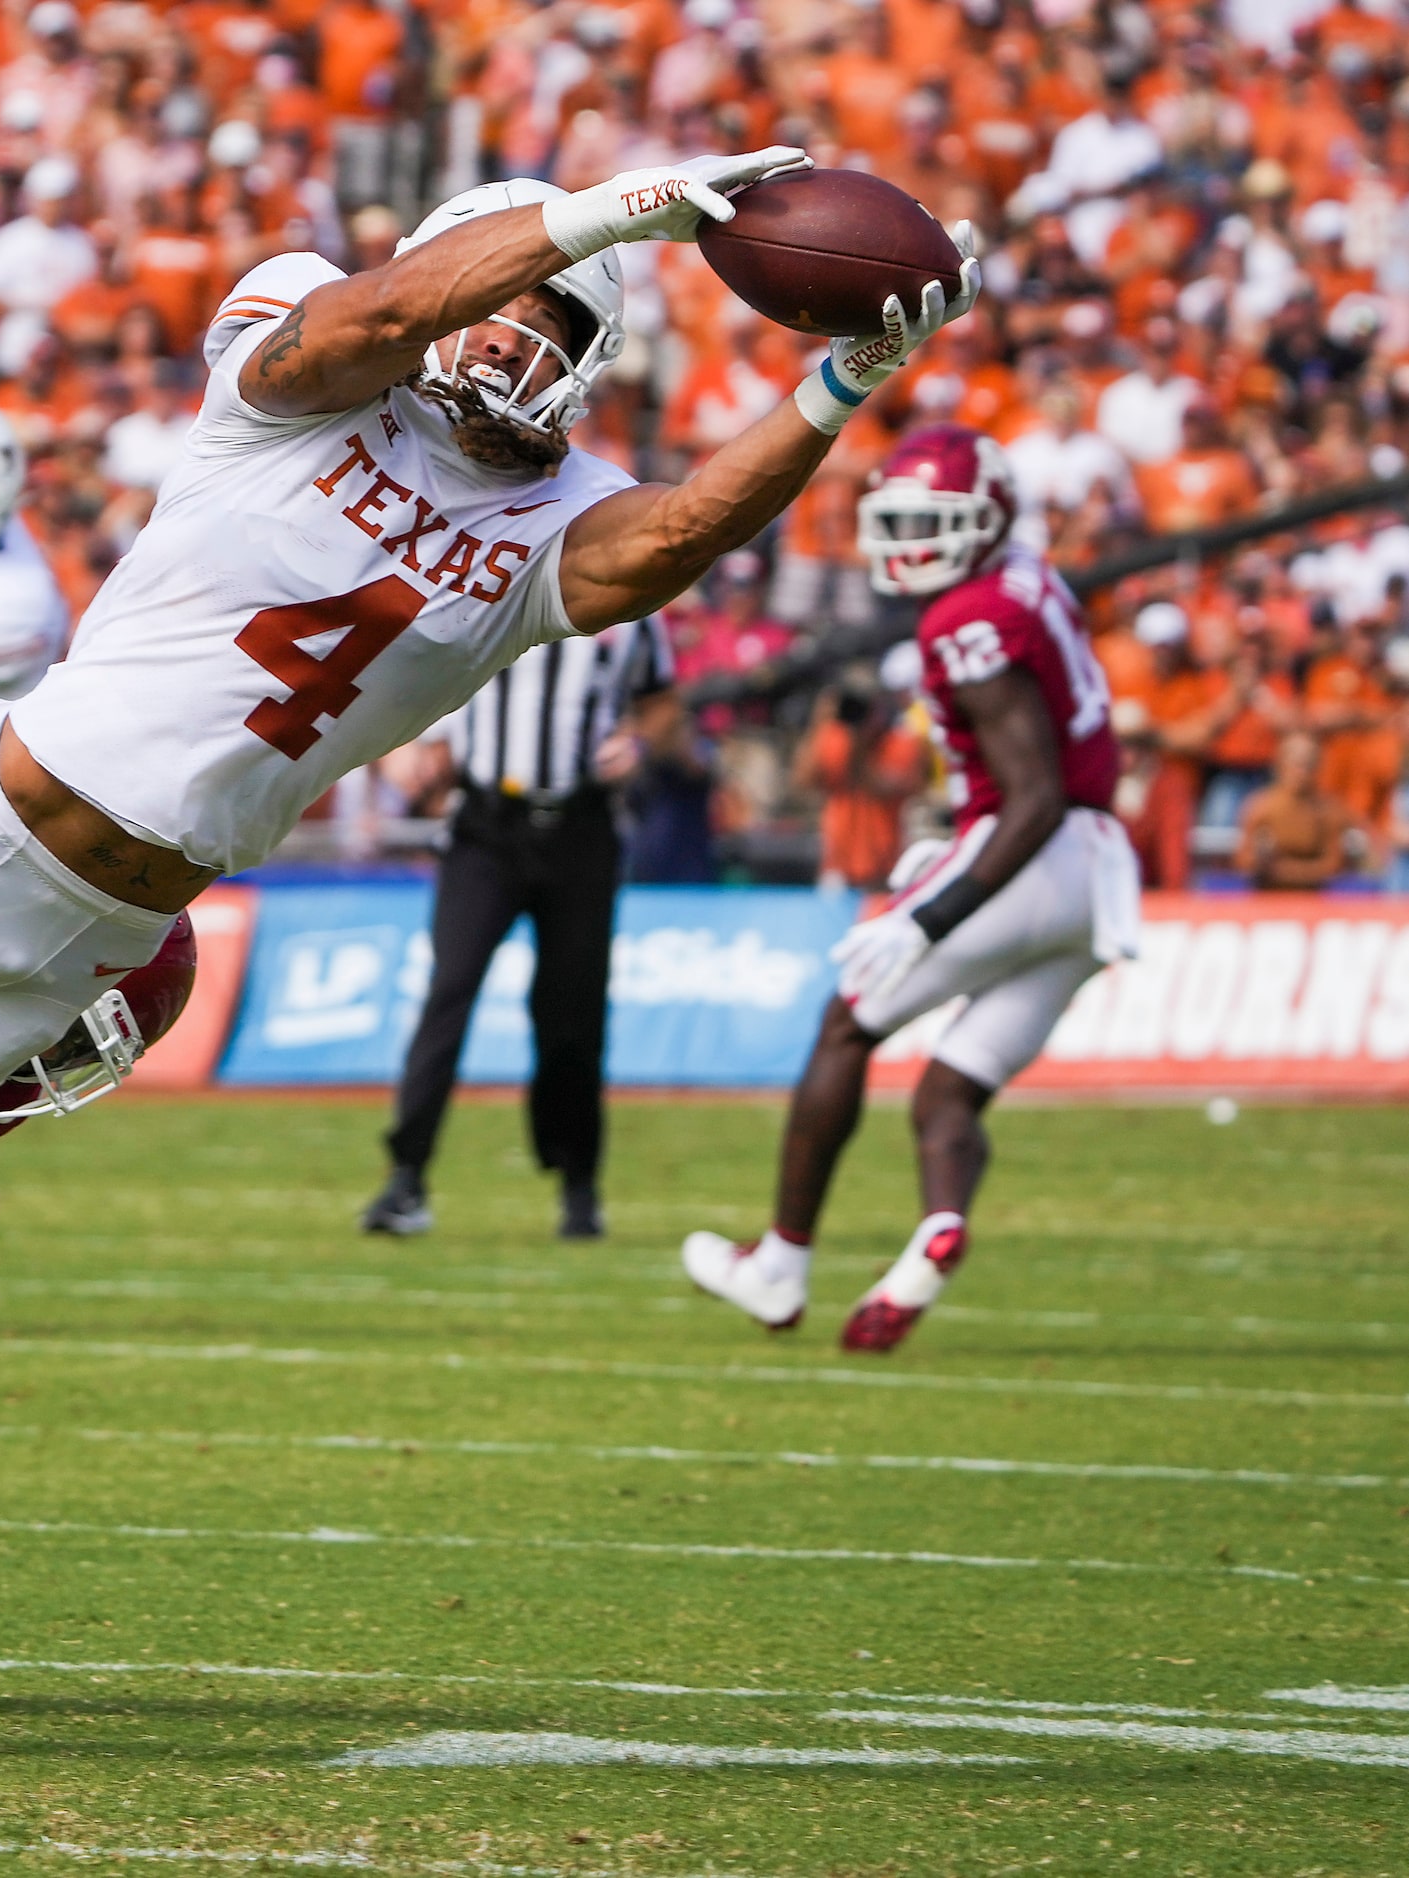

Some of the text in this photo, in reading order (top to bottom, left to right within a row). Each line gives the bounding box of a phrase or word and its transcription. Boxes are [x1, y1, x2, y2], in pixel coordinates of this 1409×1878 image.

[313, 433, 531, 604] TEXAS
[234, 573, 428, 761] 4
[931, 619, 1010, 685] 12
